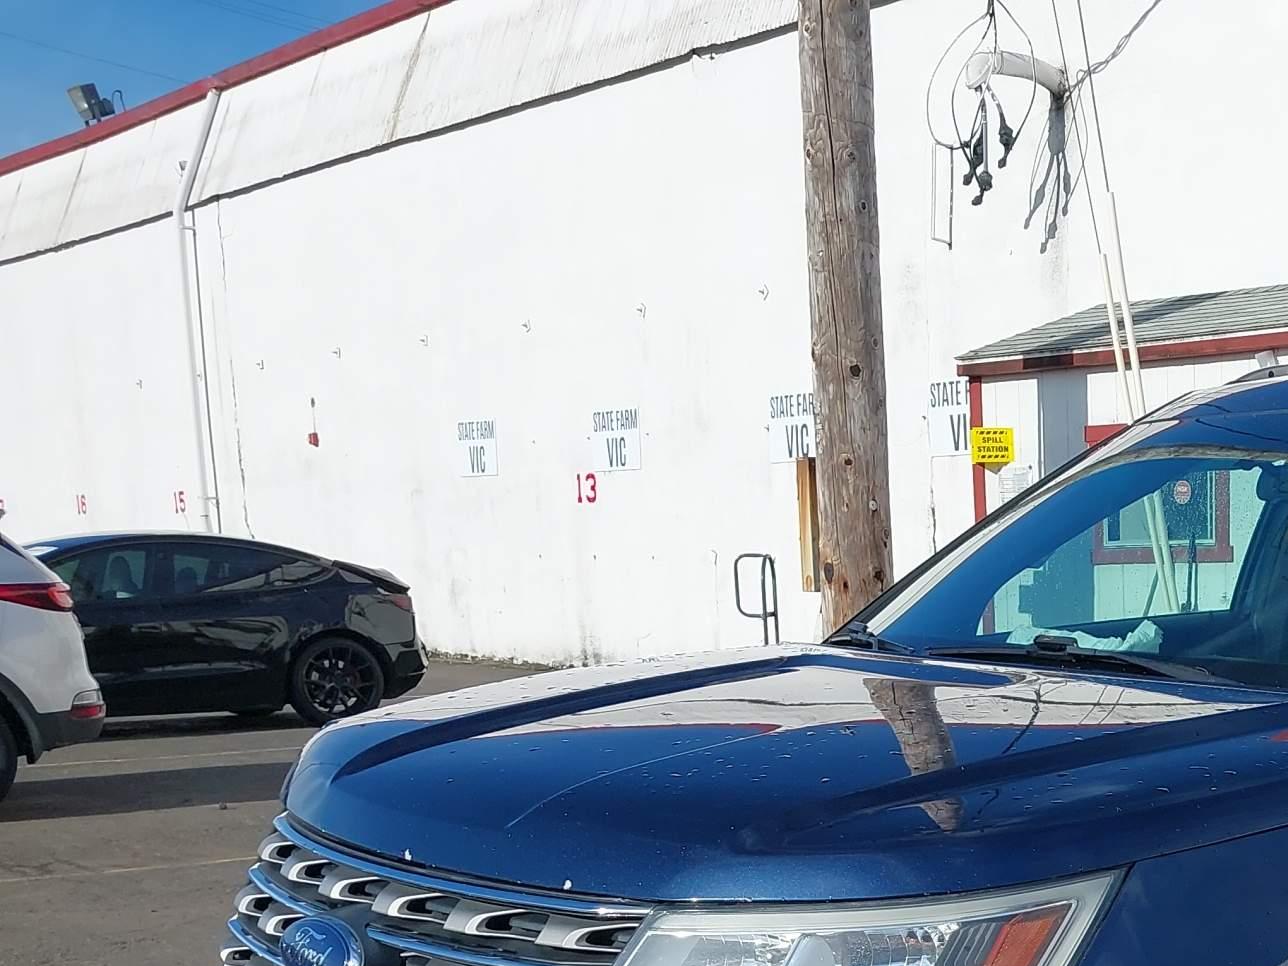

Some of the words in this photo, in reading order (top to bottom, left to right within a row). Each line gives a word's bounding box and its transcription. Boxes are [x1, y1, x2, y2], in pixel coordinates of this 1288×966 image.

[769, 395, 795, 419] STATE
[796, 393, 815, 417] FAR
[929, 381, 962, 408] STATE
[457, 422, 476, 441] STATE
[476, 419, 496, 440] FARM
[592, 411, 615, 433] STATE
[615, 408, 638, 431] FARM
[949, 413, 968, 452] VI
[606, 436, 627, 468] VIC
[785, 424, 810, 458] VIC
[976, 445, 1009, 453] STATION
[981, 436, 1003, 444] SPILL
[469, 446, 486, 474] VIC
[575, 472, 598, 504] 13
[173, 490, 187, 514] 15
